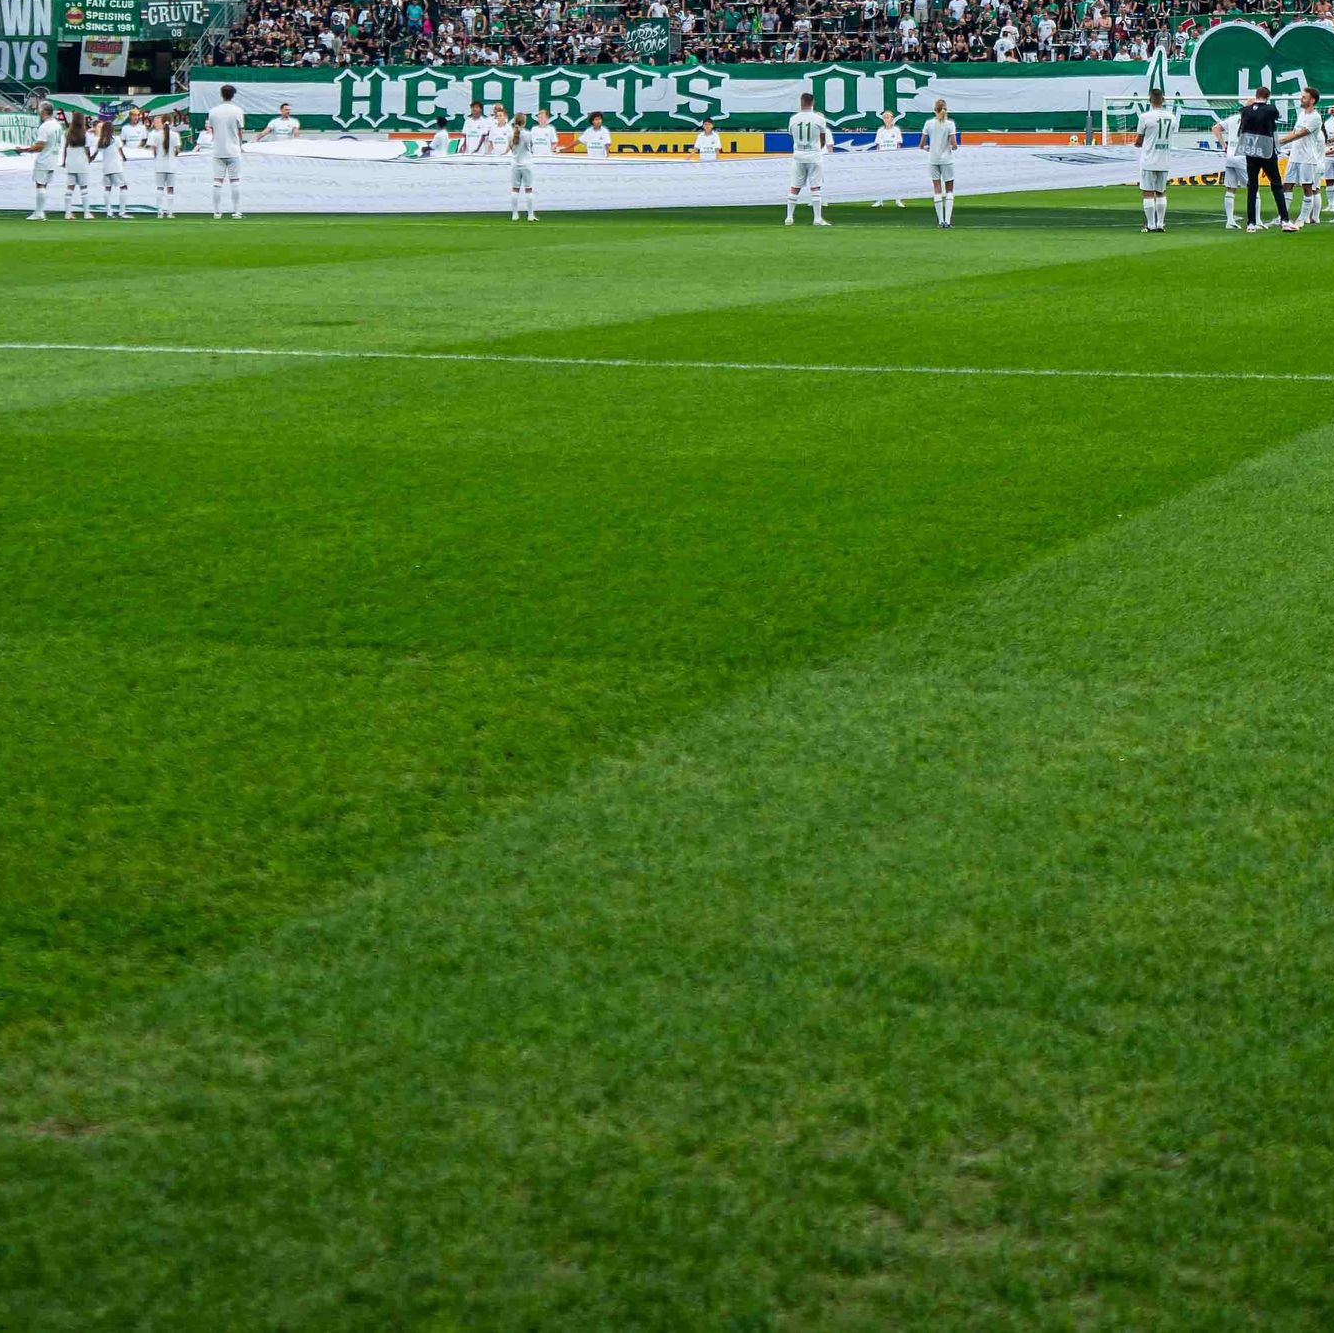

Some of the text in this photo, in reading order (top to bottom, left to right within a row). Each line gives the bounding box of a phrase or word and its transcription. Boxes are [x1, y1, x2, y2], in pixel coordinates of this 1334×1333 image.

[85, 0, 134, 8] FAN CLUB
[85, 11, 132, 21] SPEISING
[85, 22, 114, 31] SINCE
[171, 29, 182, 37] 08
[334, 65, 729, 128] HEARTS
[804, 64, 937, 127] OF
[797, 121, 811, 142] 11
[1157, 117, 1172, 140] 17
